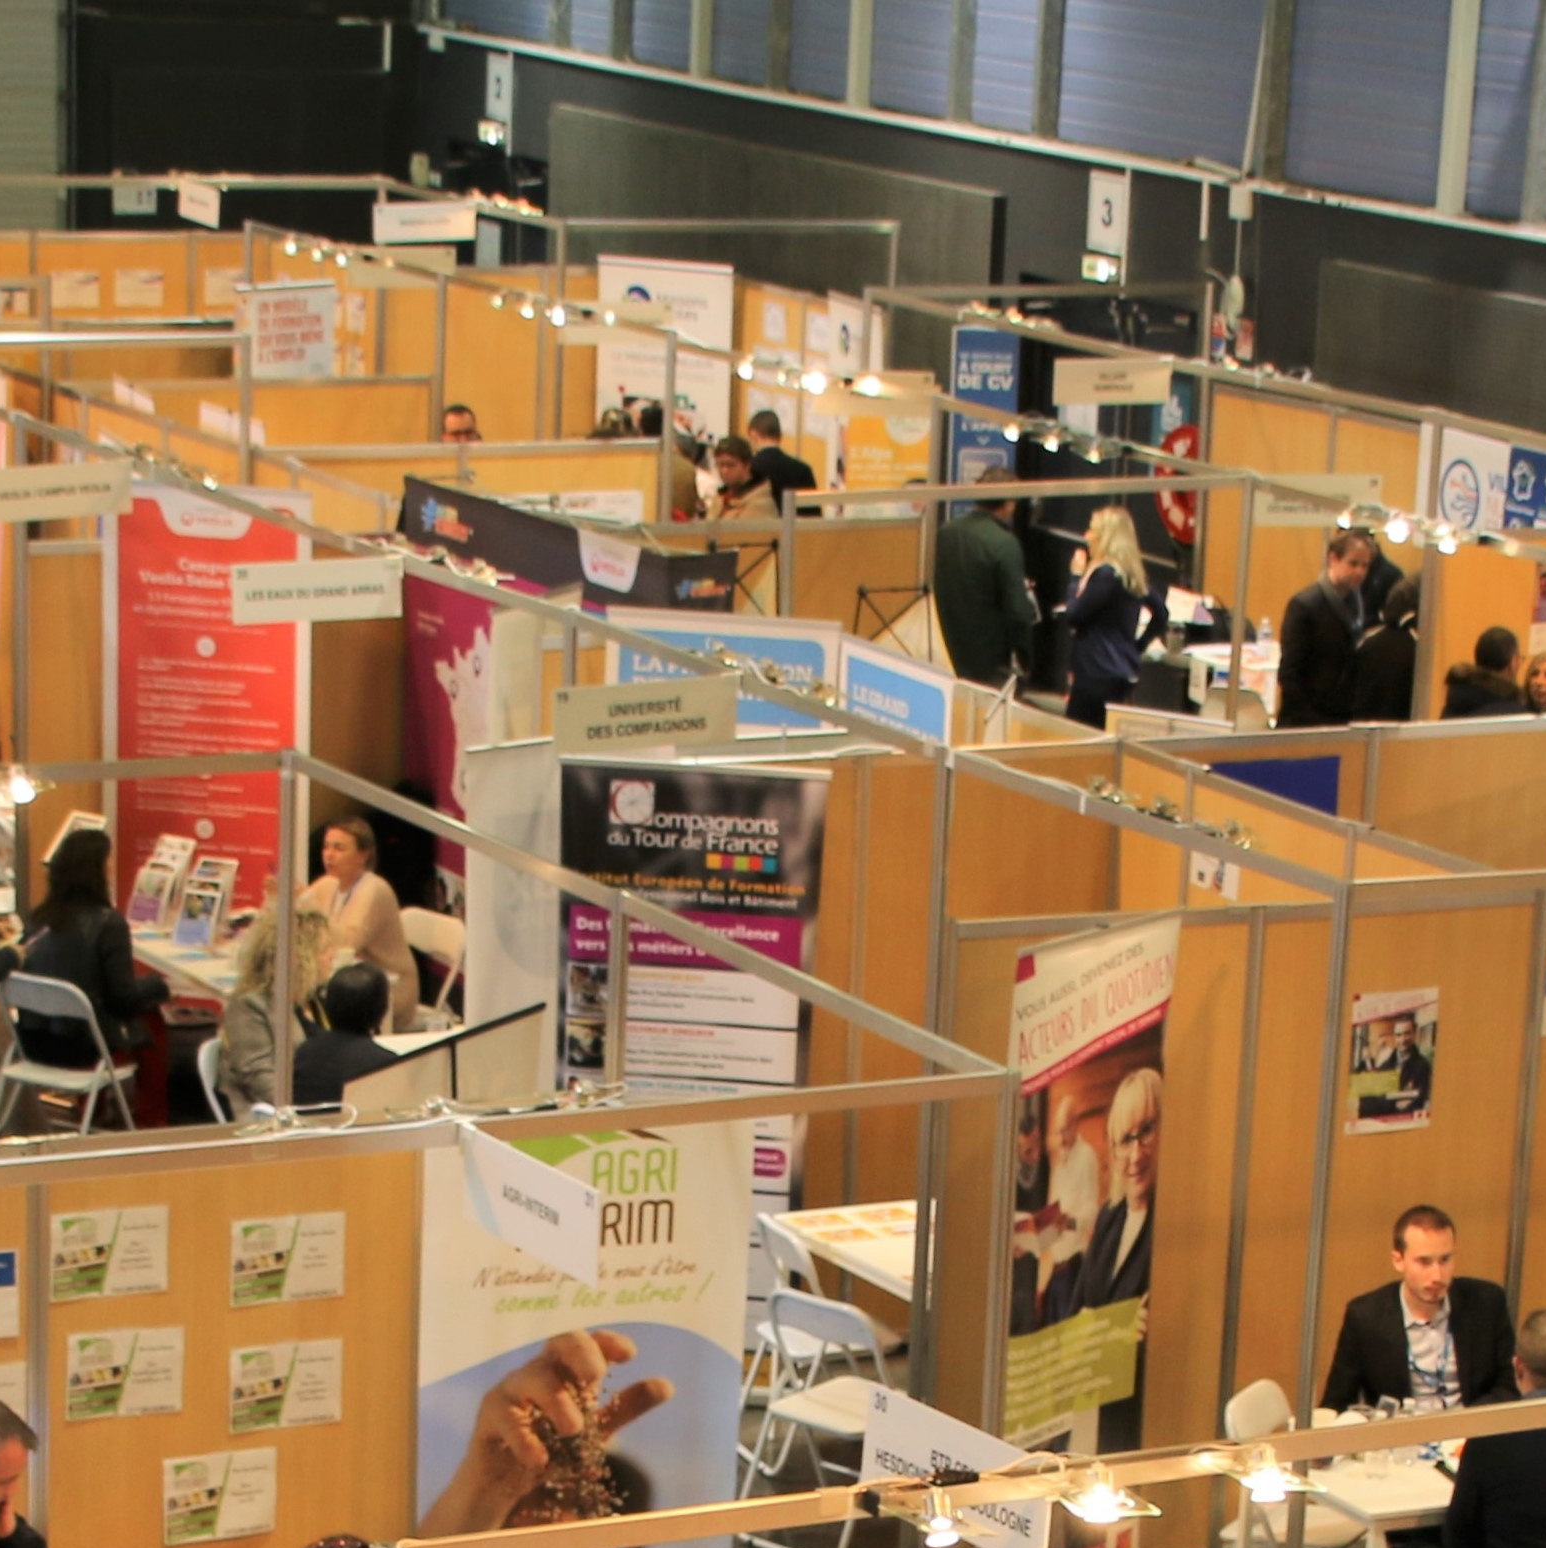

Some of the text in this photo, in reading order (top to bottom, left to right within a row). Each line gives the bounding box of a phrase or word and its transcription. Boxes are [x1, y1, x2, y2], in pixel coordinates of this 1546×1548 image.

[1101, 198, 1113, 228] 3
[958, 374, 1014, 391] DE CV
[608, 696, 682, 718] UNIVERSITÉ
[587, 717, 706, 740] DES COMPAGNONS
[608, 827, 778, 856] du Tour de France
[1019, 1006, 1075, 1066] ACTEURS
[593, 1147, 678, 1196] AGRI
